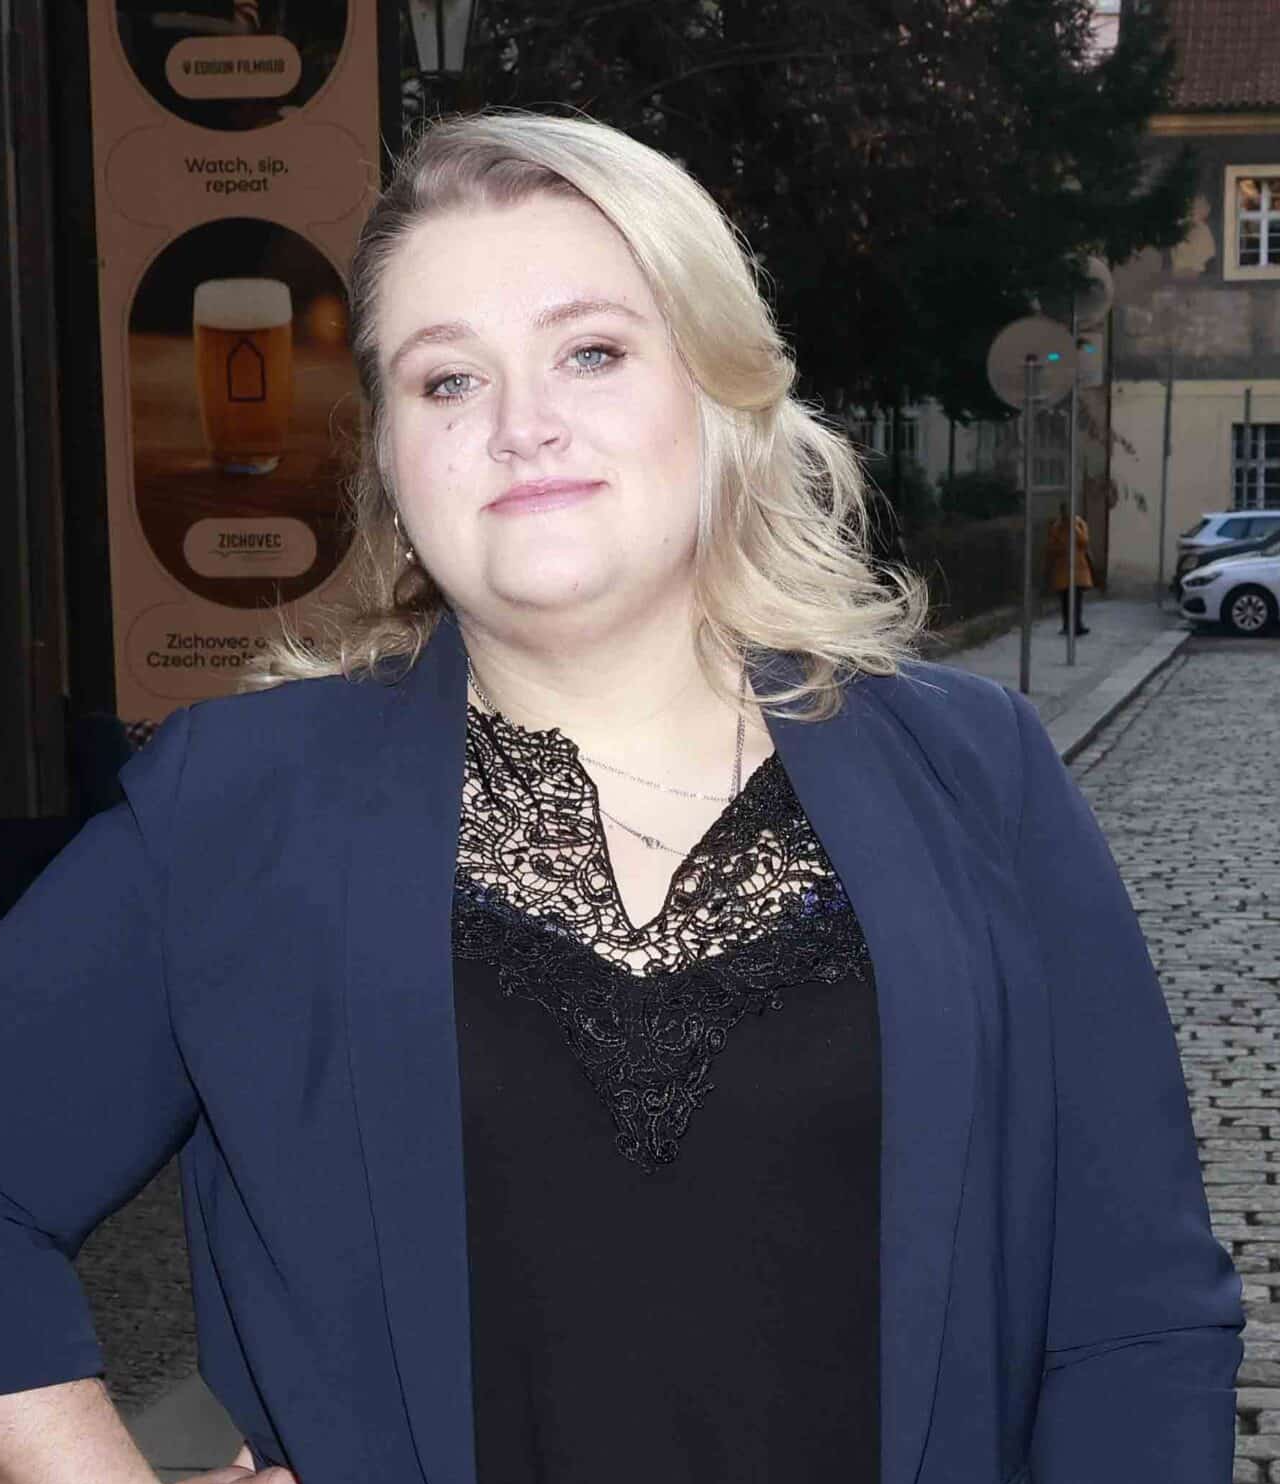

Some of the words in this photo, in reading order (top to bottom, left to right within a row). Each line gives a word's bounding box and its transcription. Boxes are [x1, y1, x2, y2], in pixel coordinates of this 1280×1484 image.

[184, 155, 252, 177] Watch,
[257, 155, 289, 177] sip,
[206, 177, 268, 195] repeat
[218, 532, 281, 549] ZICHOVEC
[166, 633, 249, 650] Zichovec
[146, 652, 205, 668] Czech
